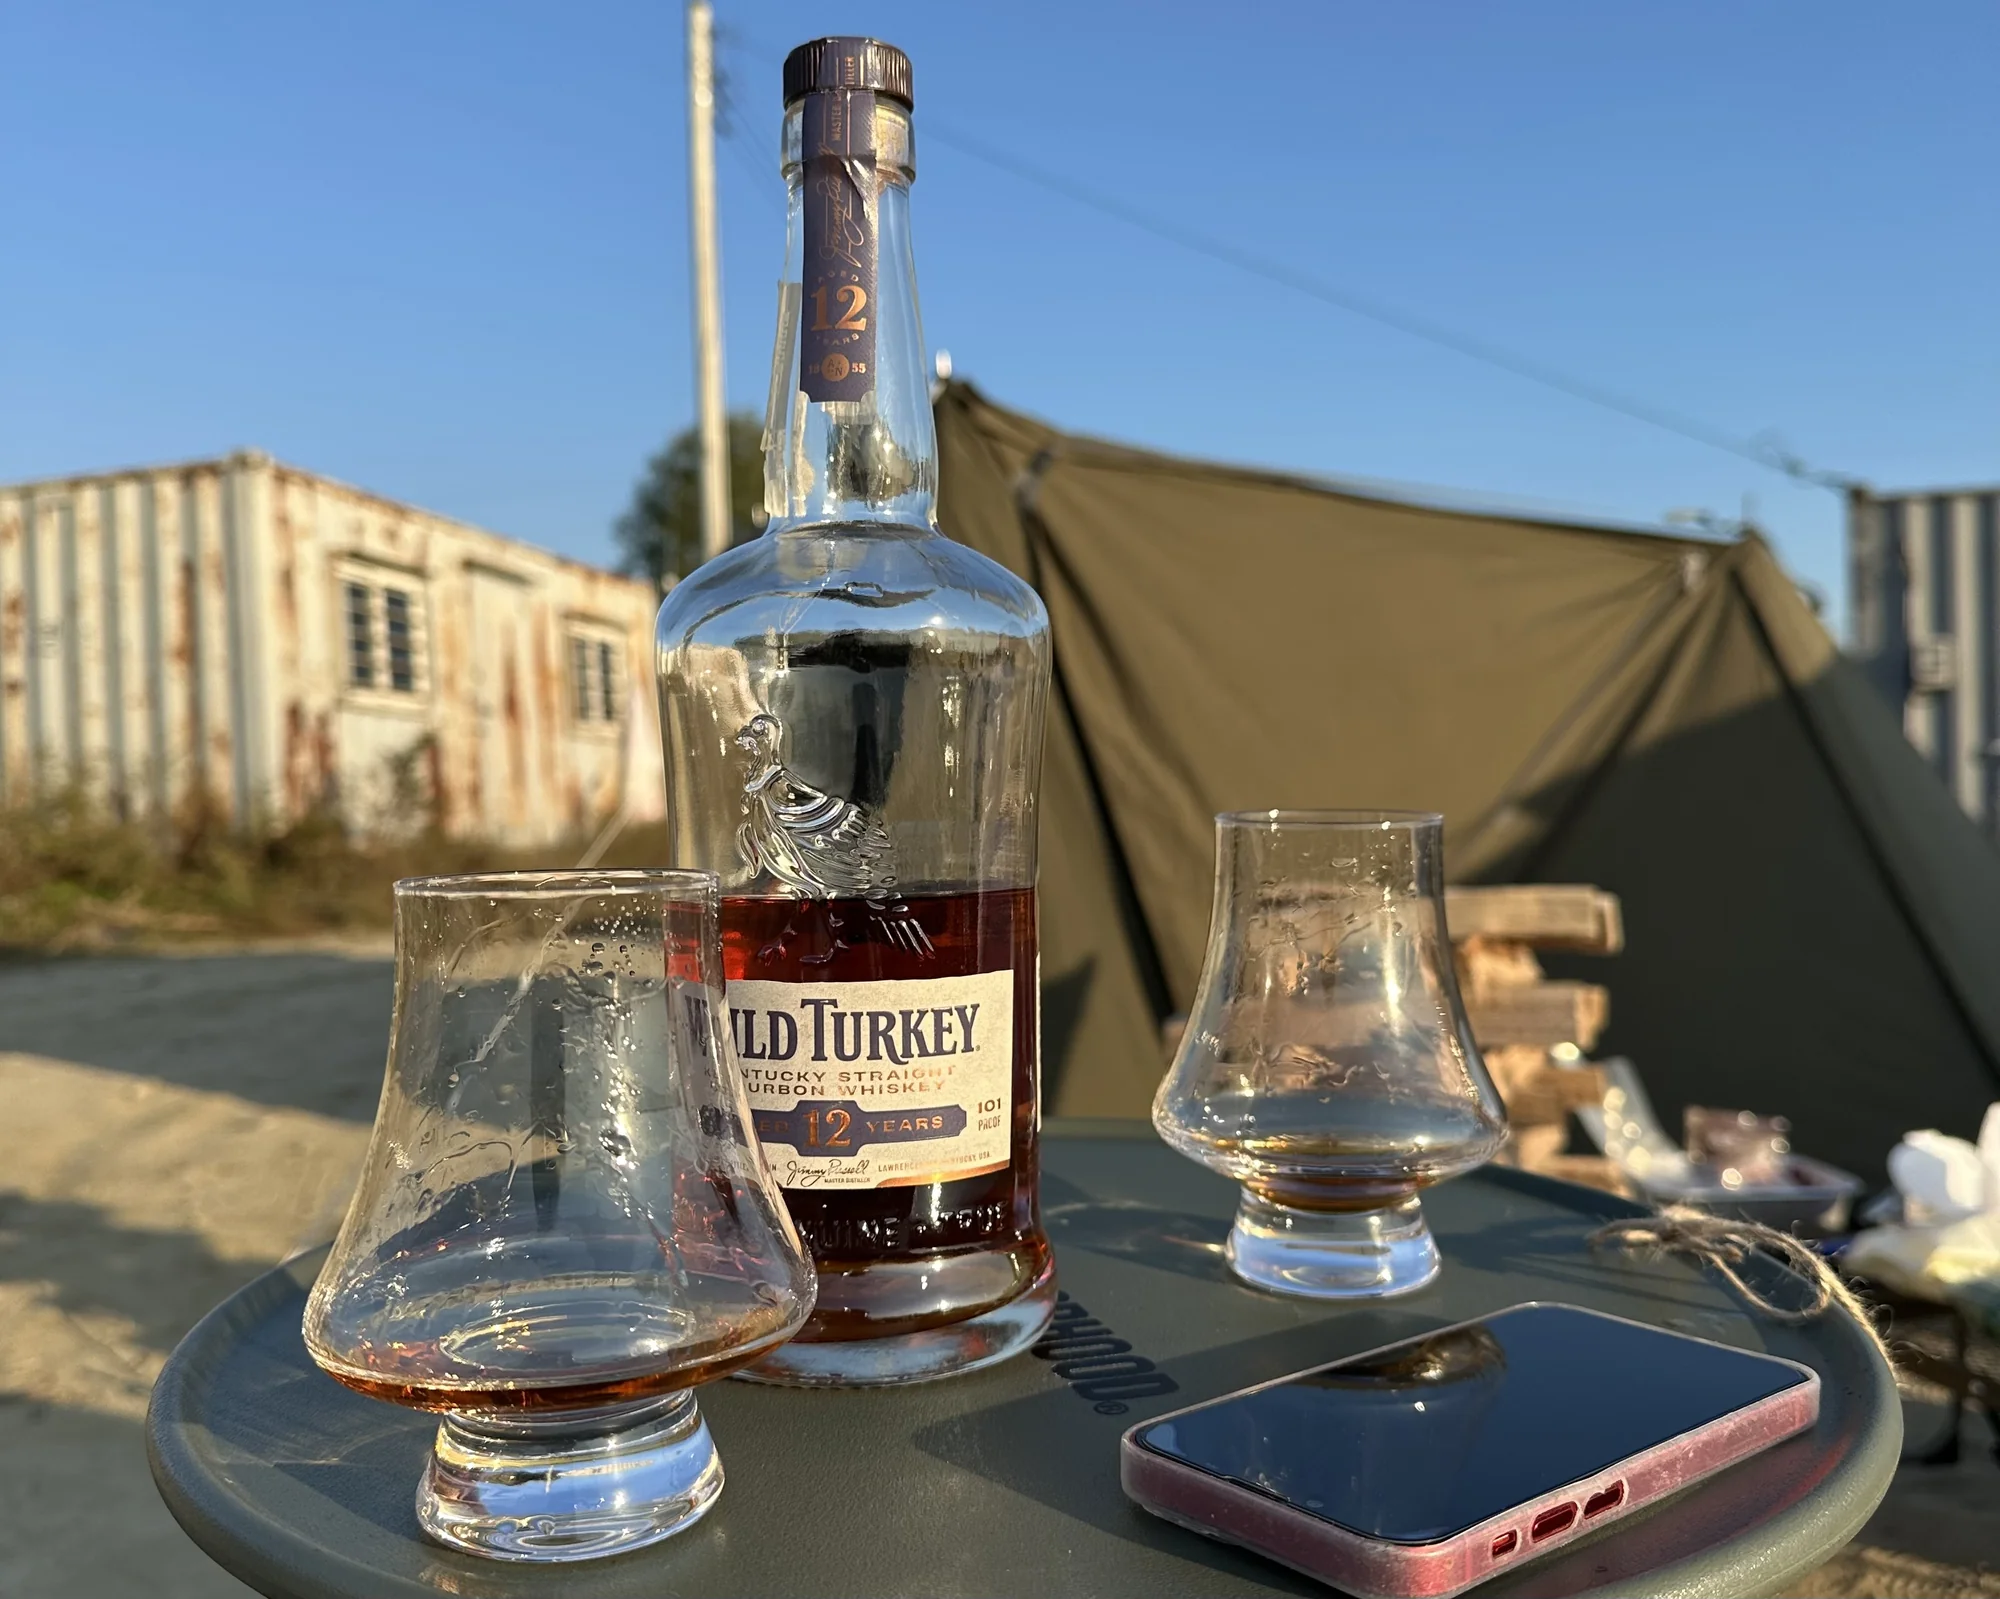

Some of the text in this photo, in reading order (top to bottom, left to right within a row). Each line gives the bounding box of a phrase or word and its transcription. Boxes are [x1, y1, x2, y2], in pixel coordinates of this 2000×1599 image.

[810, 285, 867, 331] 12
[852, 362, 867, 374] 55
[800, 998, 980, 1065] TURKEY
[838, 1065, 956, 1082] STRAIGHT
[748, 1081, 946, 1097] URBON WHISKEY
[978, 1097, 1001, 1114] 101
[802, 1108, 851, 1148] 12
[865, 1115, 943, 1133] YEARS
